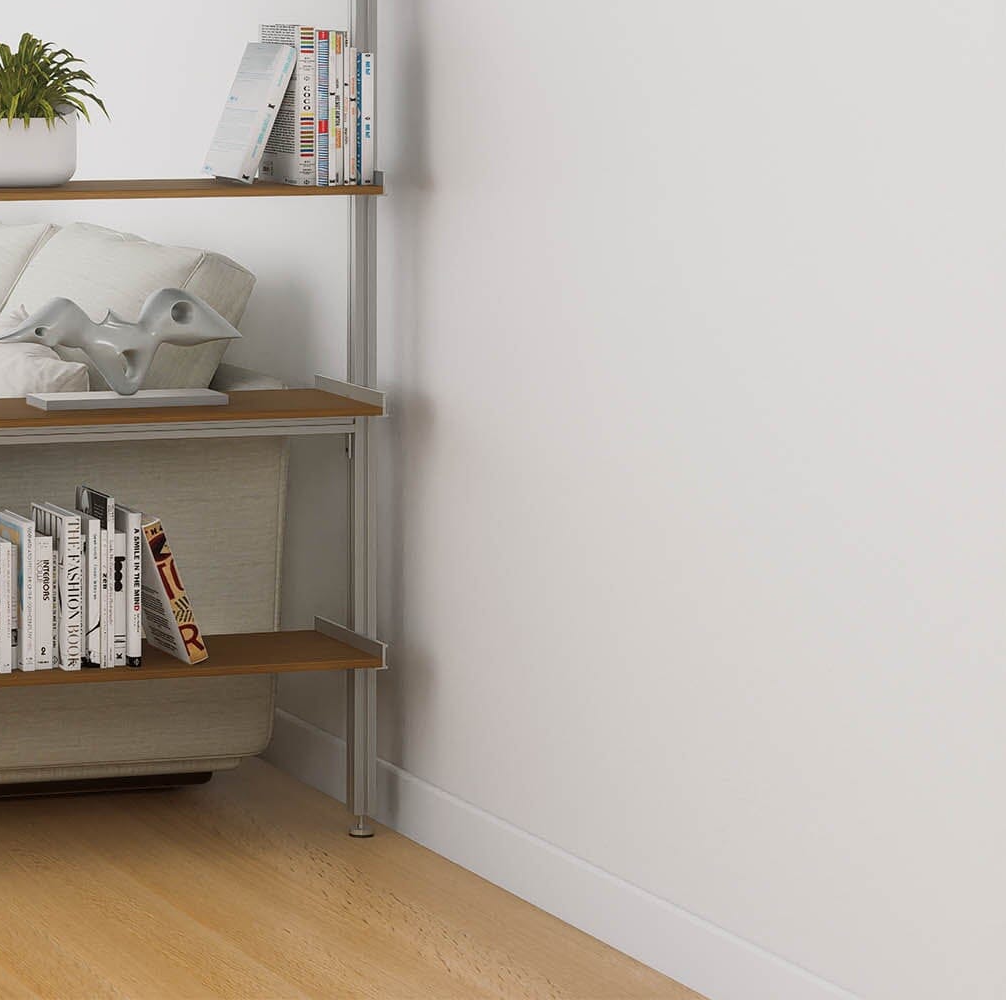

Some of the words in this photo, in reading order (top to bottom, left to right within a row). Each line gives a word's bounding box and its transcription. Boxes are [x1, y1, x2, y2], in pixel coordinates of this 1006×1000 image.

[67, 518, 79, 551] THE
[134, 562, 140, 570] IN
[67, 554, 79, 620] FASHION
[41, 647, 46, 656] 2
[67, 624, 80, 668] BOOK
